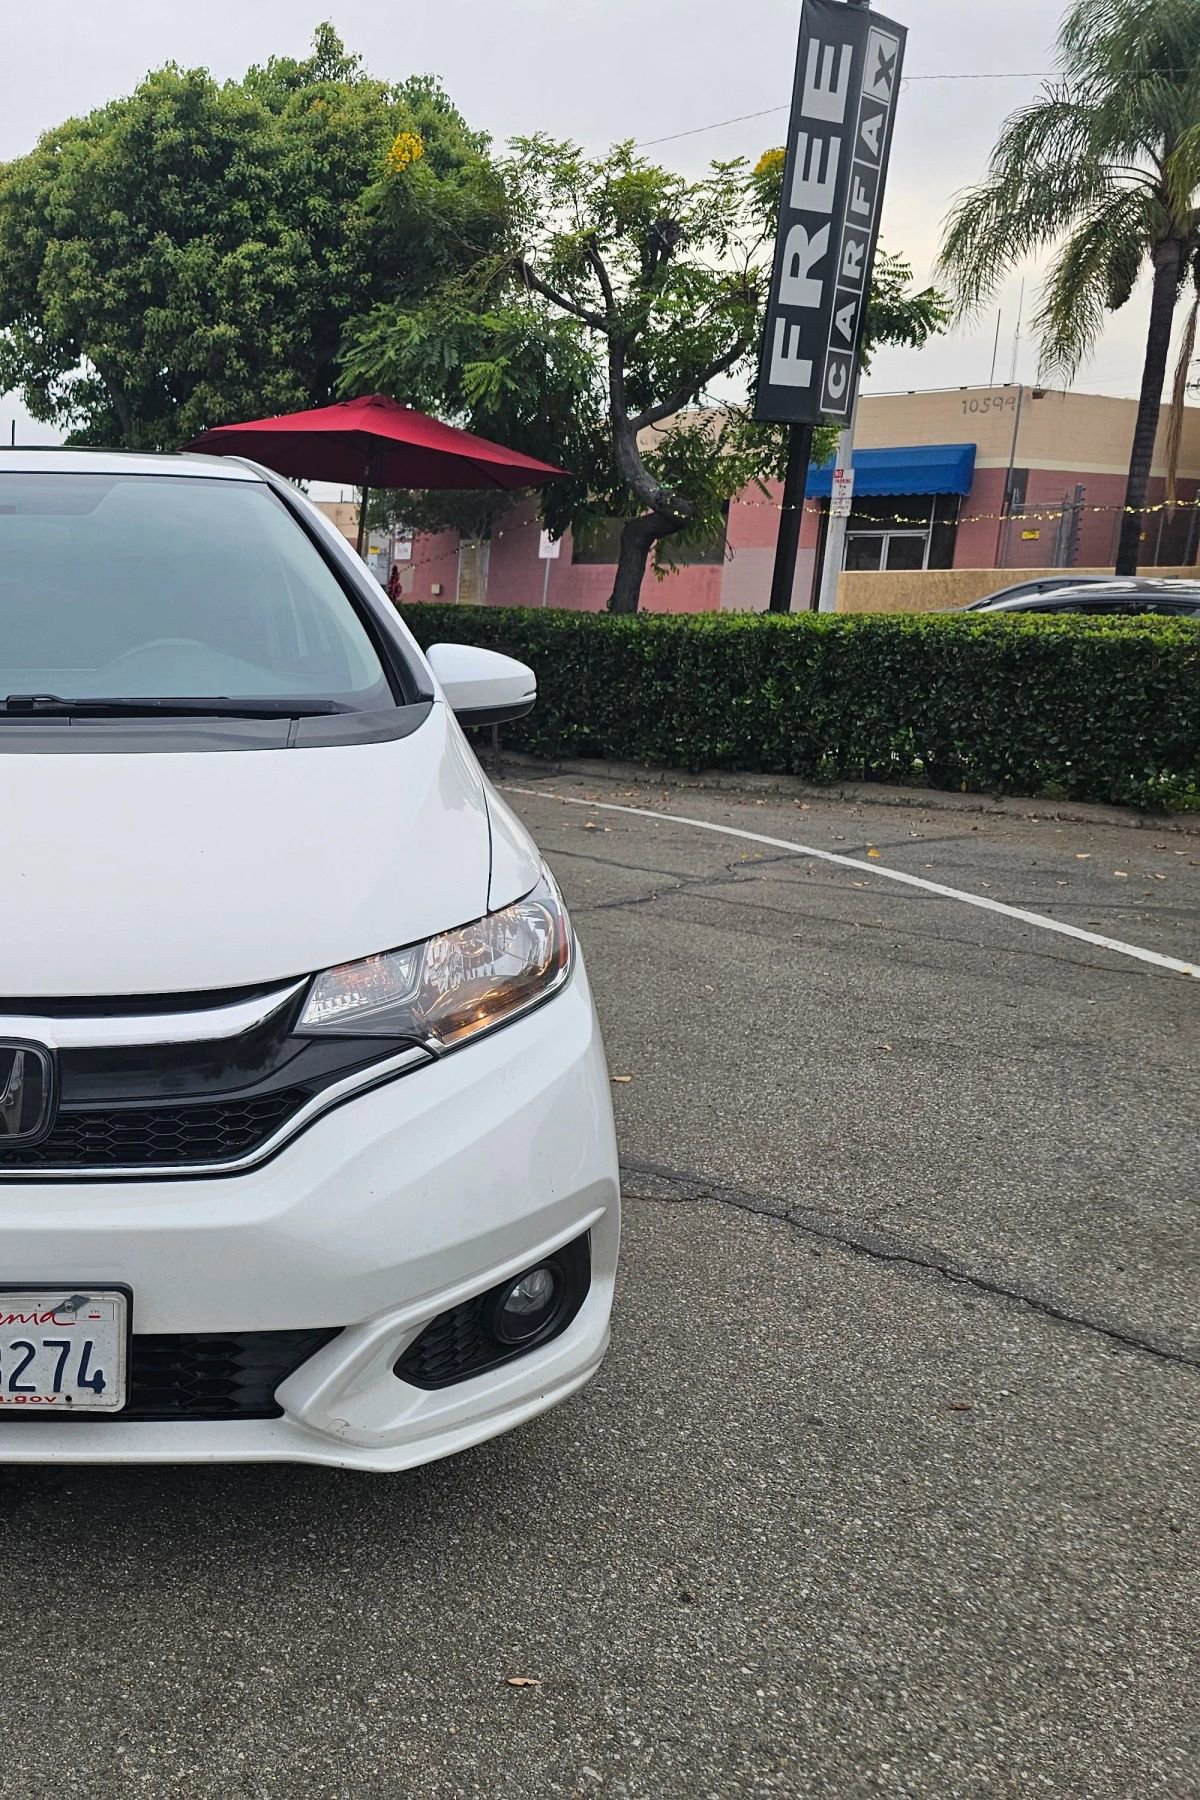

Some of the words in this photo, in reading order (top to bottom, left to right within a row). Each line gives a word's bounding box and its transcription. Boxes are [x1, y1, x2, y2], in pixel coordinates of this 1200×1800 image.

[768, 37, 854, 389] FREE
[827, 42, 897, 400] CARFAX
[961, 395, 1017, 415] 10594
